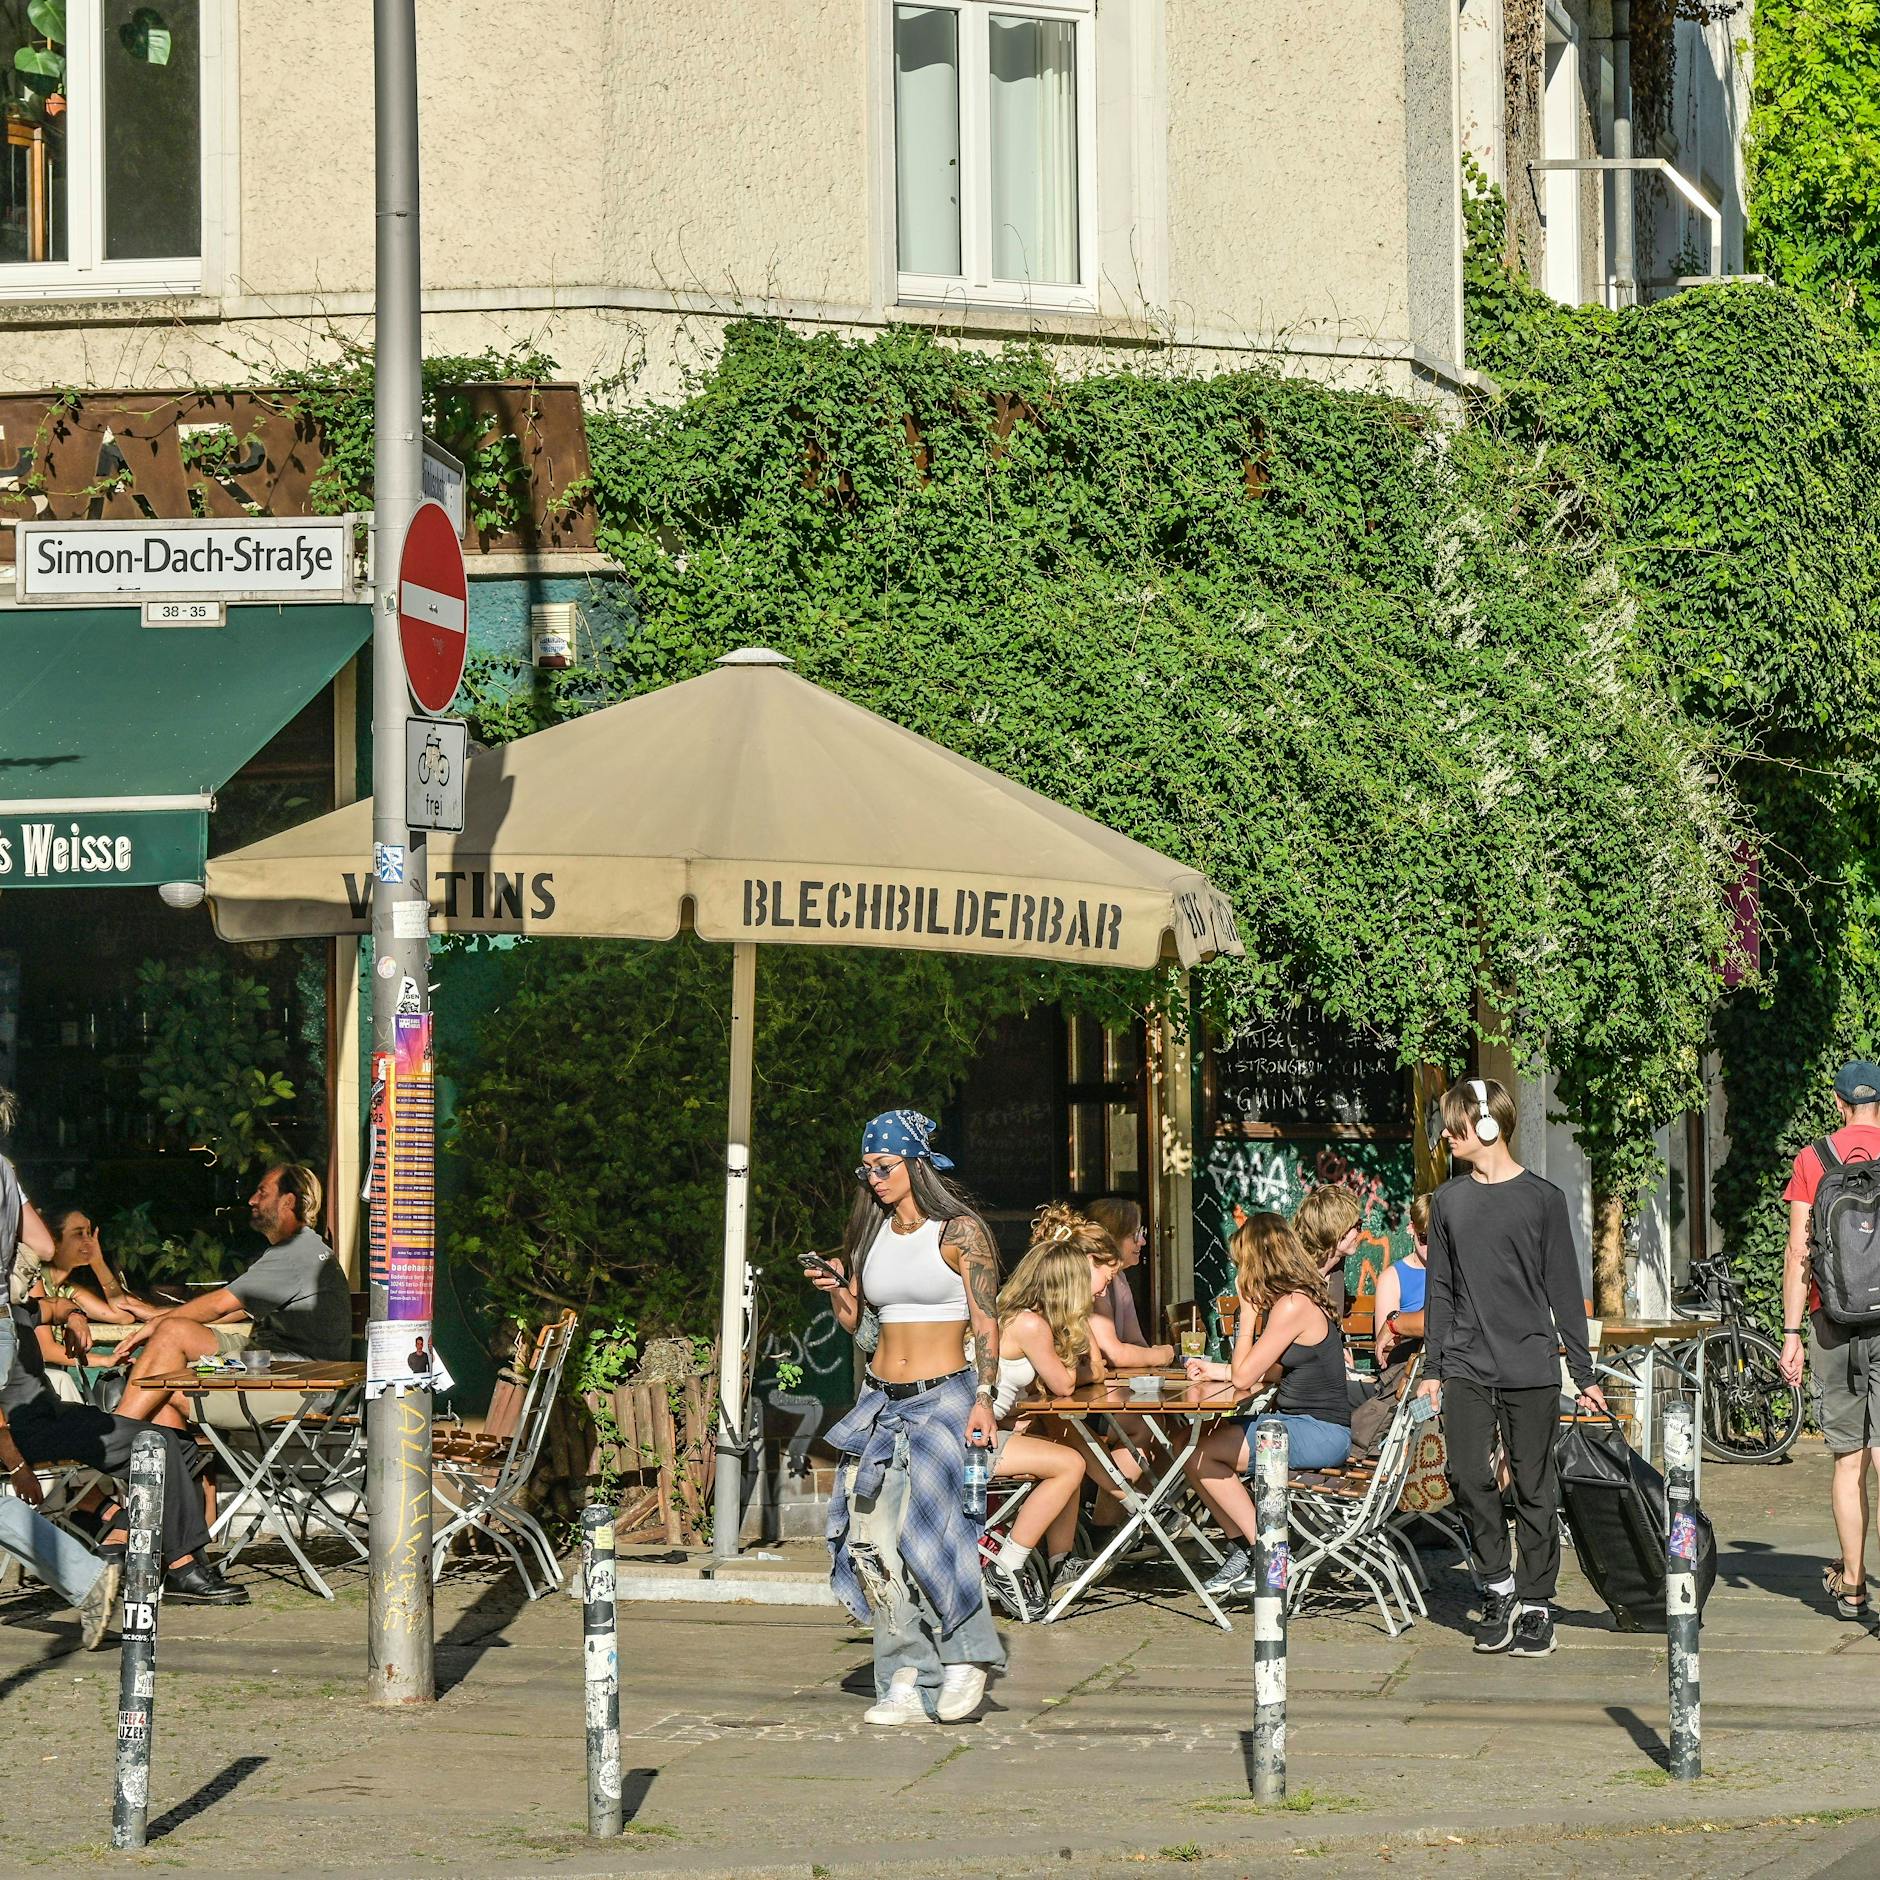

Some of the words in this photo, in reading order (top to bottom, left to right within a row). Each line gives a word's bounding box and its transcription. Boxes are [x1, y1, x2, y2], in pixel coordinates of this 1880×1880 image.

[37, 535, 332, 580] Simon-Dach-Straße
[425, 790, 443, 819] frei
[21, 822, 132, 877] Weisse
[341, 871, 555, 920] VTINS
[743, 879, 1123, 950] BLECHBILDERBAR
[122, 1603, 153, 1630] TB
